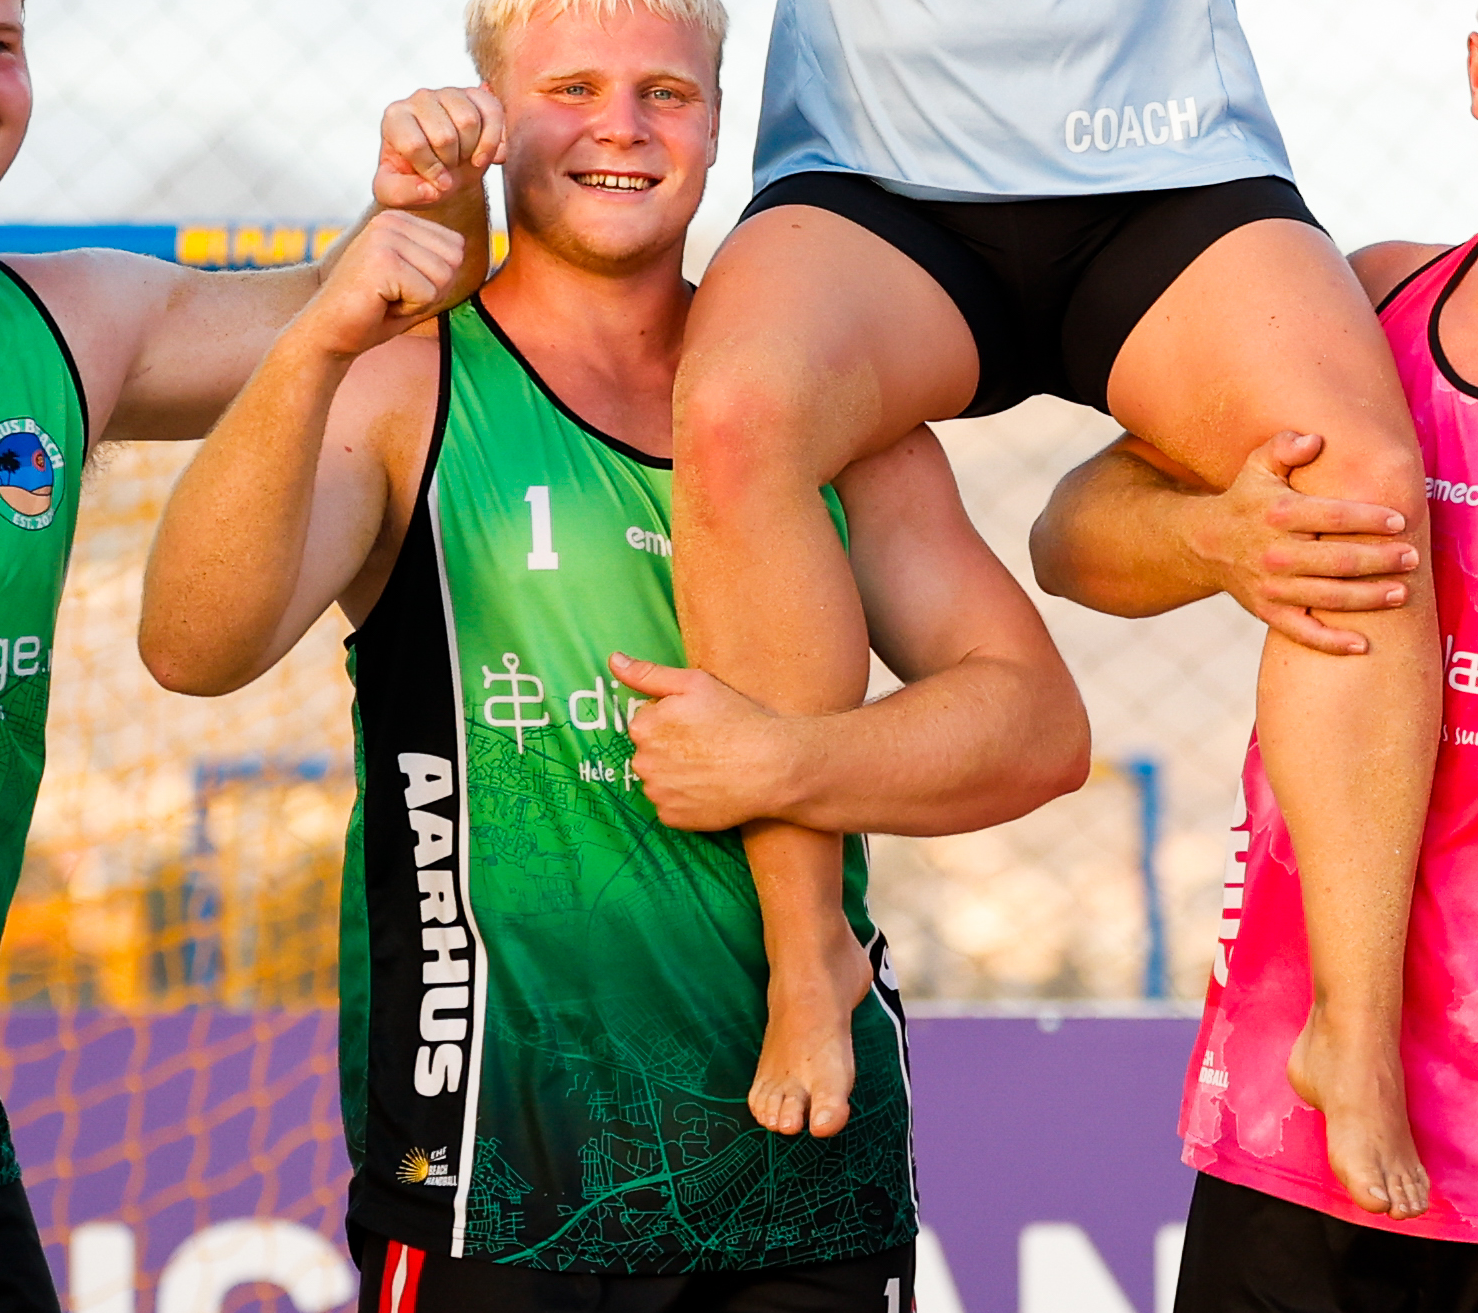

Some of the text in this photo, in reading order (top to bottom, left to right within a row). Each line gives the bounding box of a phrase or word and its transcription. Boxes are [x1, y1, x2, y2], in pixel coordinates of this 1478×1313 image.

[1063, 96, 1201, 154] COACH
[523, 484, 561, 571] 1
[578, 760, 616, 783] Hele
[396, 751, 471, 1098] AARHUS
